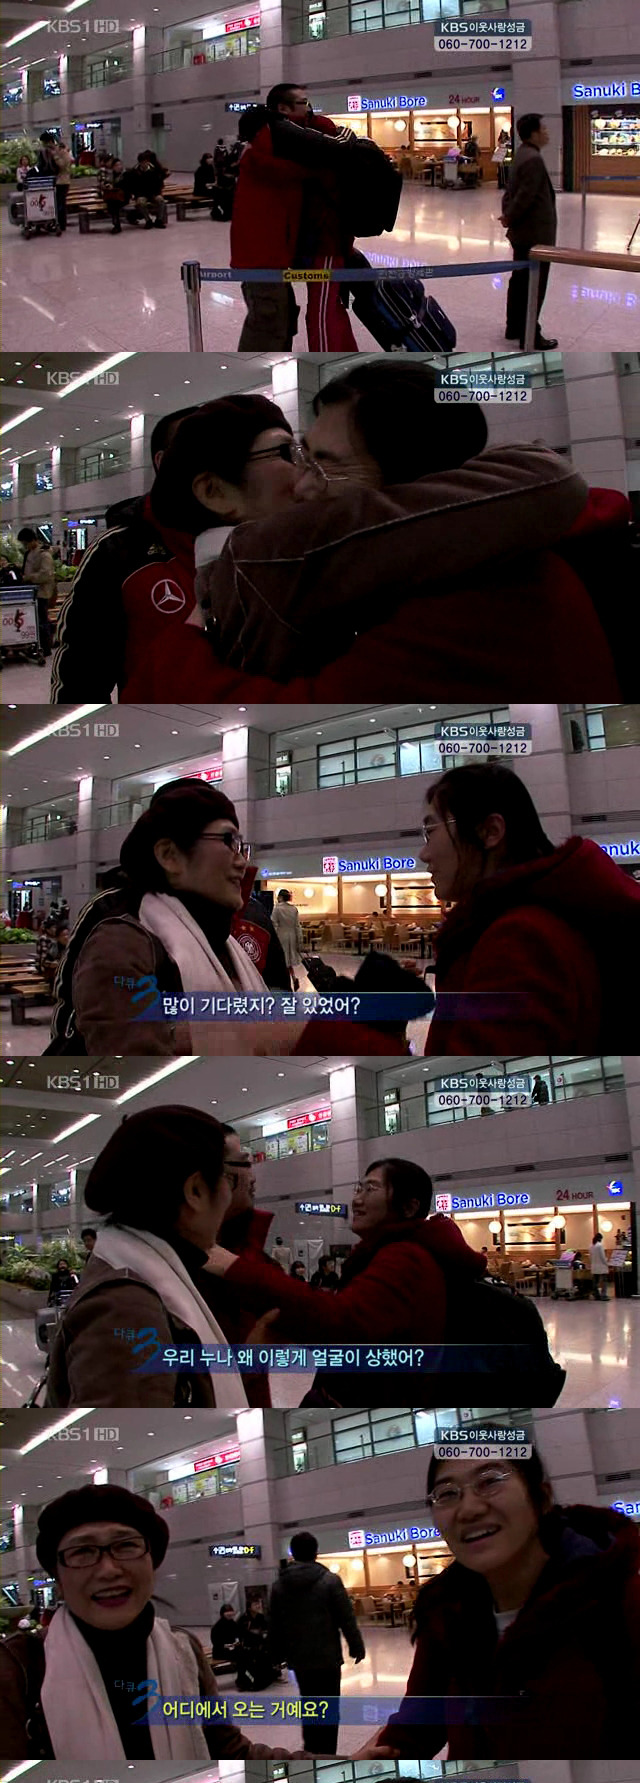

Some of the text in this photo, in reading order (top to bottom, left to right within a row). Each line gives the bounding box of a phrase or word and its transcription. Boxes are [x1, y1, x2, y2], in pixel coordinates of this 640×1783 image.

[573, 82, 627, 98] Sanuki
[361, 95, 427, 110] Sanuki Bore
[449, 95, 460, 104] 24
[284, 271, 329, 280] Customs
[338, 856, 416, 872] Sanuki Bore
[452, 1192, 529, 1209] Sanuki Bore
[556, 1189, 594, 1200] 24 HOUR
[365, 1528, 407, 1545] Sanuki
